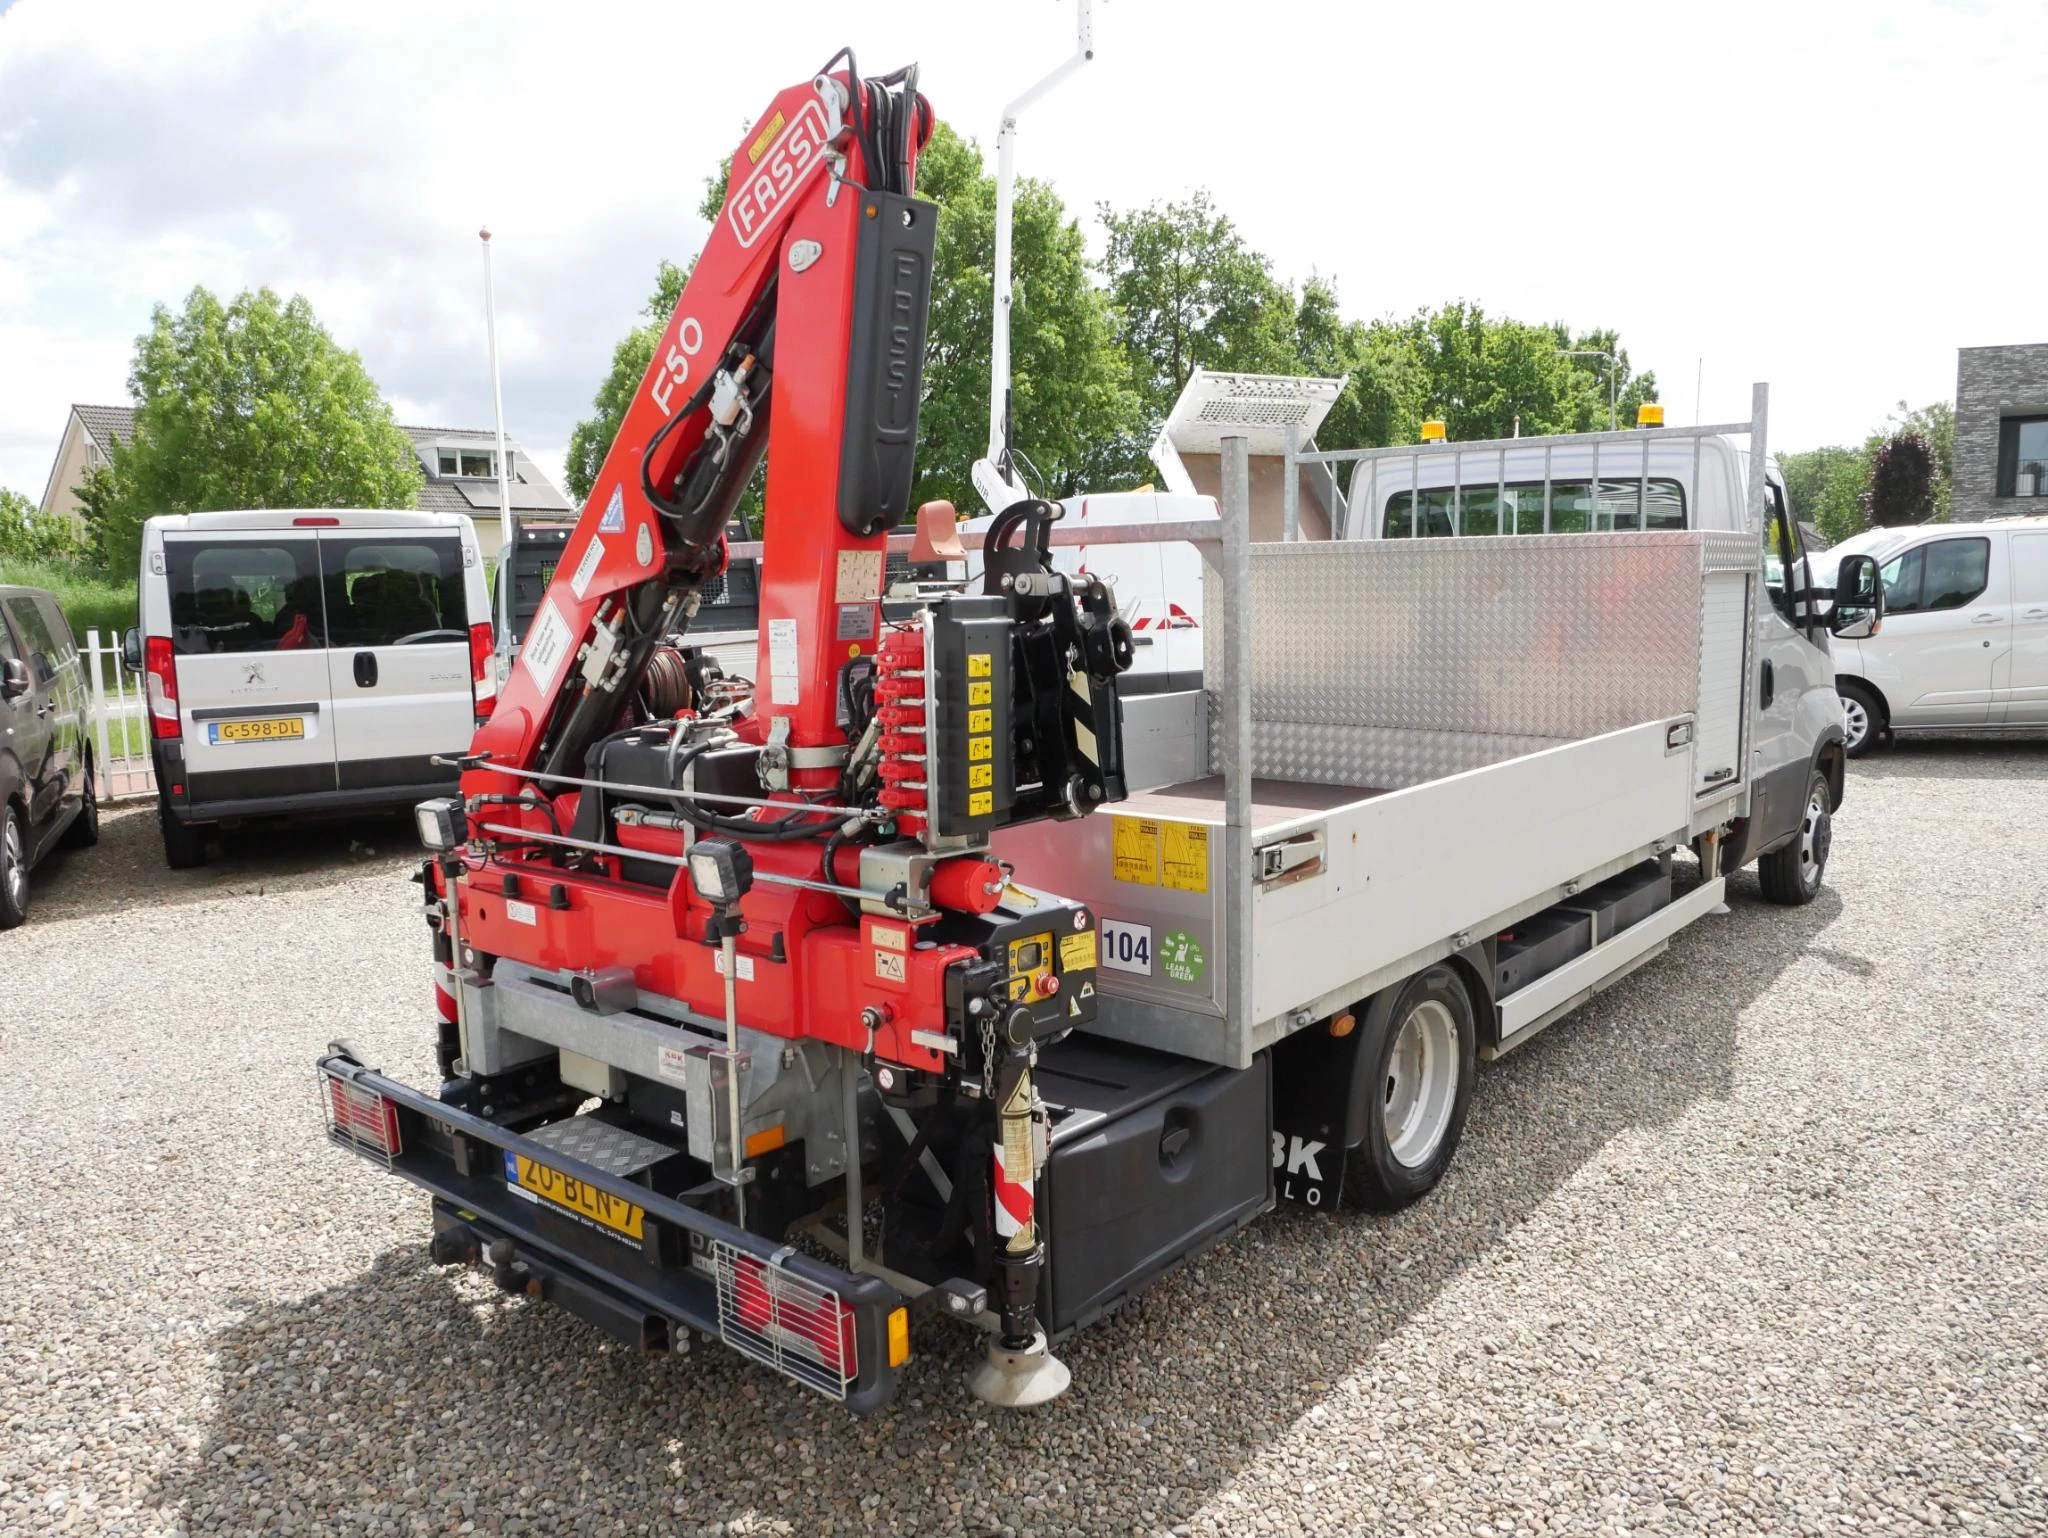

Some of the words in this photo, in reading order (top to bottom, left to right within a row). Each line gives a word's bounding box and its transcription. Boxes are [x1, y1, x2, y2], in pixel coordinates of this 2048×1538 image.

[738, 116, 820, 232] FASSI
[651, 316, 703, 416] F50
[224, 720, 299, 738] G-598-DL
[1103, 929, 1149, 965] 104
[1165, 962, 1184, 972] LEAN
[1170, 970, 1194, 982] GREEN
